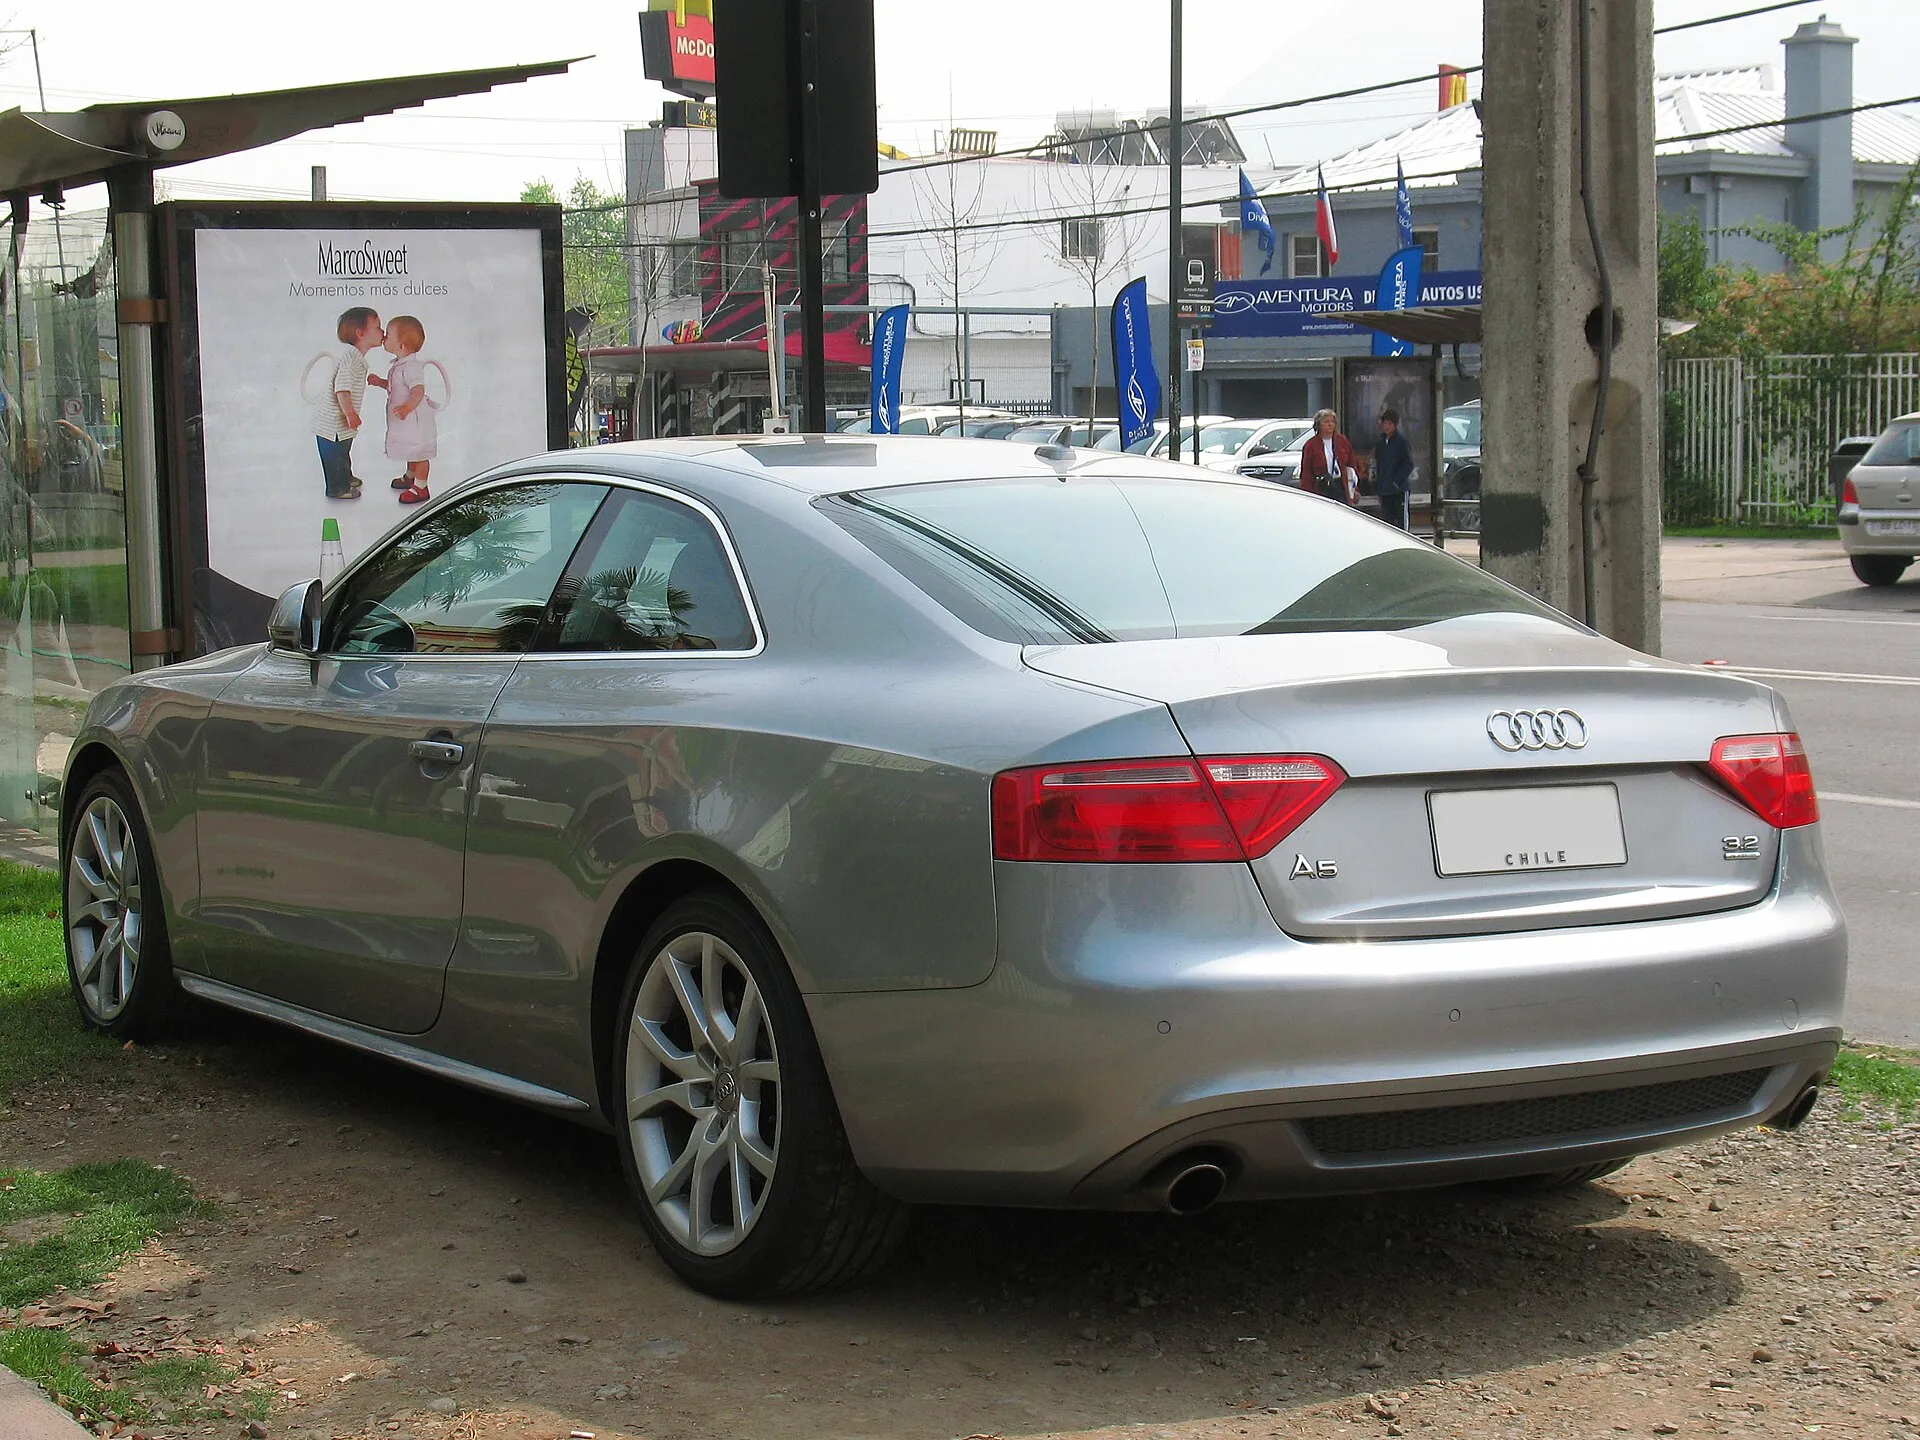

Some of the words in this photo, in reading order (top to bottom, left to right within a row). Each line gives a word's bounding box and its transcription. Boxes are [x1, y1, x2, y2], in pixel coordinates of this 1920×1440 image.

[318, 239, 408, 275] MarcoSweet
[289, 282, 365, 296] Momentos
[370, 282, 398, 296] más
[403, 280, 448, 296] dulces
[1256, 287, 1353, 304] AVENTURA
[1422, 285, 1464, 302] AUTOS
[1301, 302, 1354, 313] MOTORS
[1722, 835, 1759, 850] 3.2
[1505, 851, 1566, 865] CHILE
[1289, 853, 1338, 880] A5
